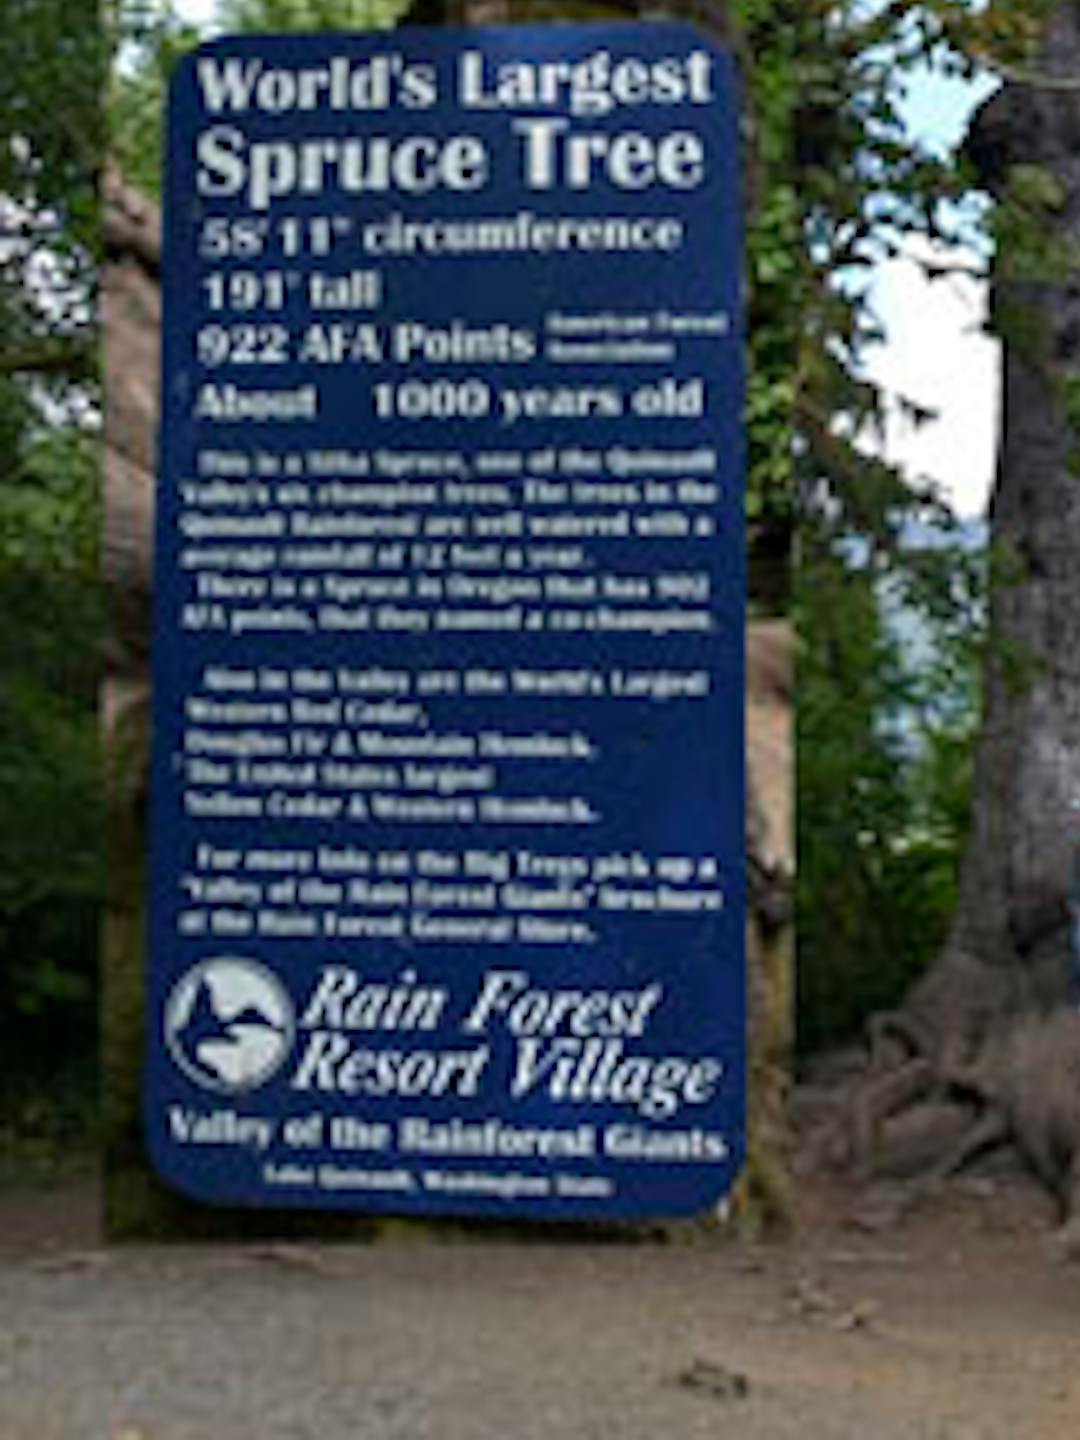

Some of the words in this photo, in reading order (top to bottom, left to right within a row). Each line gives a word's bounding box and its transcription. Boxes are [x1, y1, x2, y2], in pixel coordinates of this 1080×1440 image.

[198, 55, 436, 112] World's
[460, 51, 711, 112] Largest
[197, 126, 486, 209] Spruce
[514, 118, 703, 188] Tree
[364, 212, 682, 254] circumference
[310, 270, 380, 309] tall
[198, 325, 289, 365] 922
[299, 324, 382, 362] AFA
[394, 322, 536, 362] Points
[195, 384, 316, 420] About
[375, 380, 489, 416] 1000
[500, 388, 622, 422] years
[632, 378, 702, 416] old
[301, 967, 447, 1032] Rain
[464, 972, 661, 1040] Forest
[290, 1029, 489, 1096] Resort
[511, 1038, 721, 1118] Village
[170, 1106, 272, 1149] Valley
[284, 1114, 322, 1146] of
[331, 1117, 390, 1149] the
[399, 1118, 595, 1156] Rainforest
[604, 1124, 728, 1160] Giants
